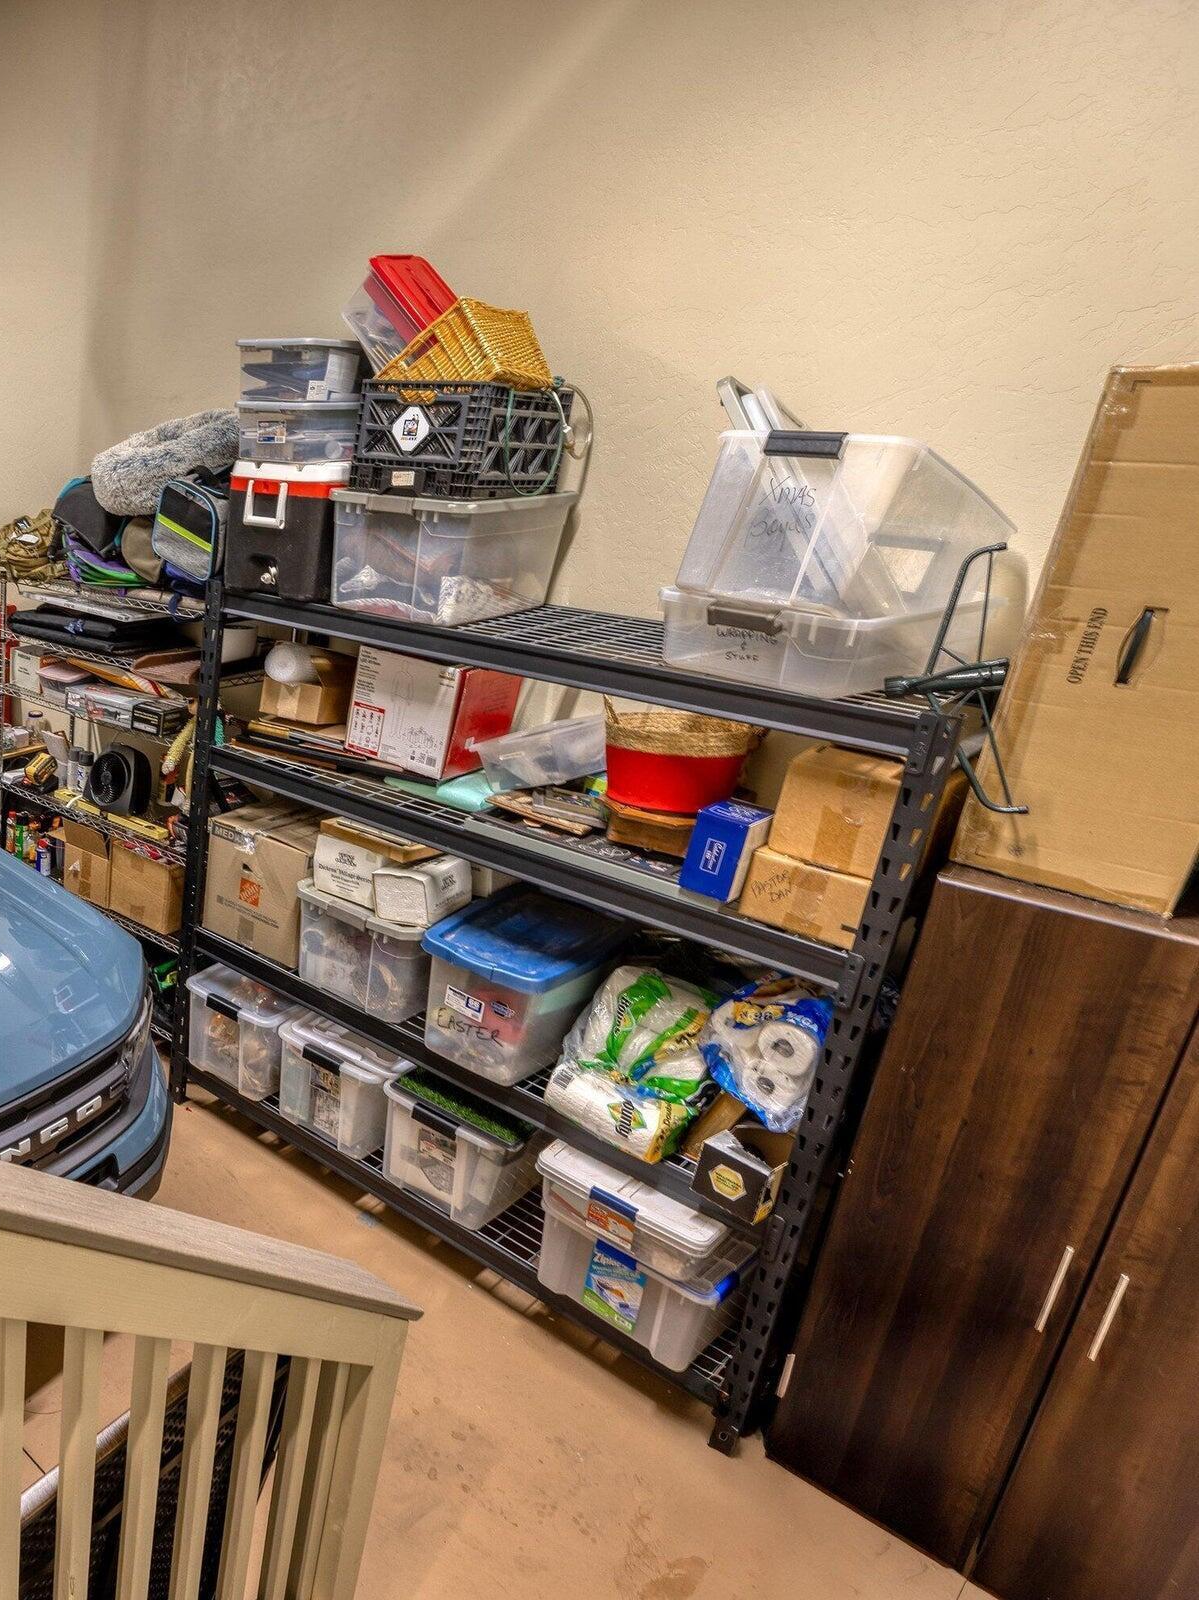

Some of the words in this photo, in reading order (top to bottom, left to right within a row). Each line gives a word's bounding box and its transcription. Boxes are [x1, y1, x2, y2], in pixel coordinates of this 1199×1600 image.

[1087, 607, 1108, 629] END
[1077, 631, 1100, 655] THIS
[1066, 656, 1090, 684] OPEN
[437, 1007, 504, 1048] EASTER
[0, 1094, 102, 1161] NCO
[614, 1099, 637, 1139] ounty
